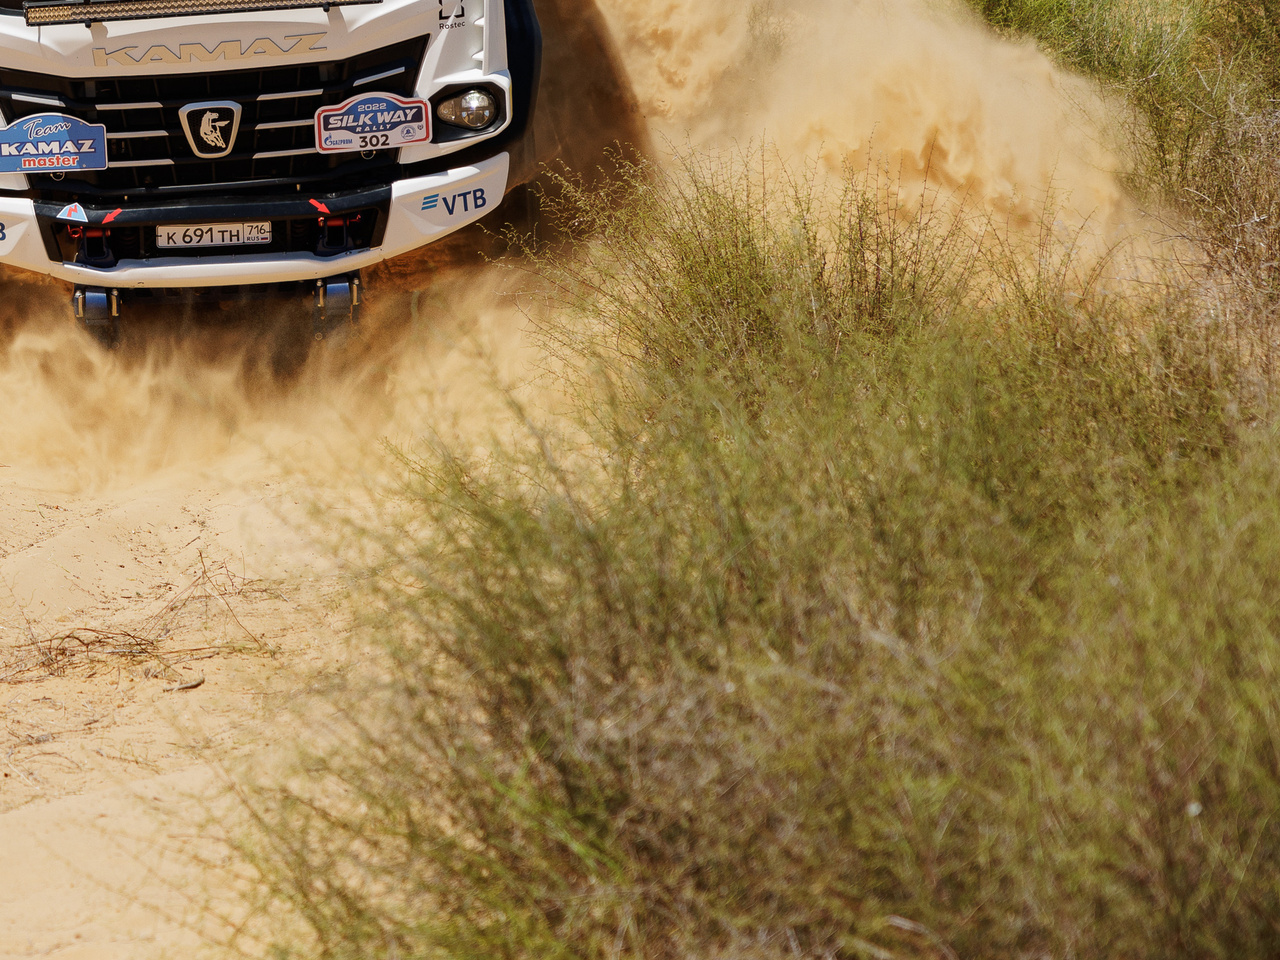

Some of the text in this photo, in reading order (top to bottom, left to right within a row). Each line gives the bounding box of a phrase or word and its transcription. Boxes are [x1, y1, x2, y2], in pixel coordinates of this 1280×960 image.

[439, 21, 465, 30] Rostec
[92, 31, 327, 66] KAMAZ
[357, 102, 387, 112] 2022
[328, 108, 418, 128] SILK WAY
[23, 119, 71, 139] Team
[356, 124, 392, 132] RALLY
[0, 140, 95, 156] KAMAZ
[359, 134, 389, 148] 302
[22, 155, 79, 168] master
[442, 188, 486, 215] VTB
[247, 224, 266, 235] 716
